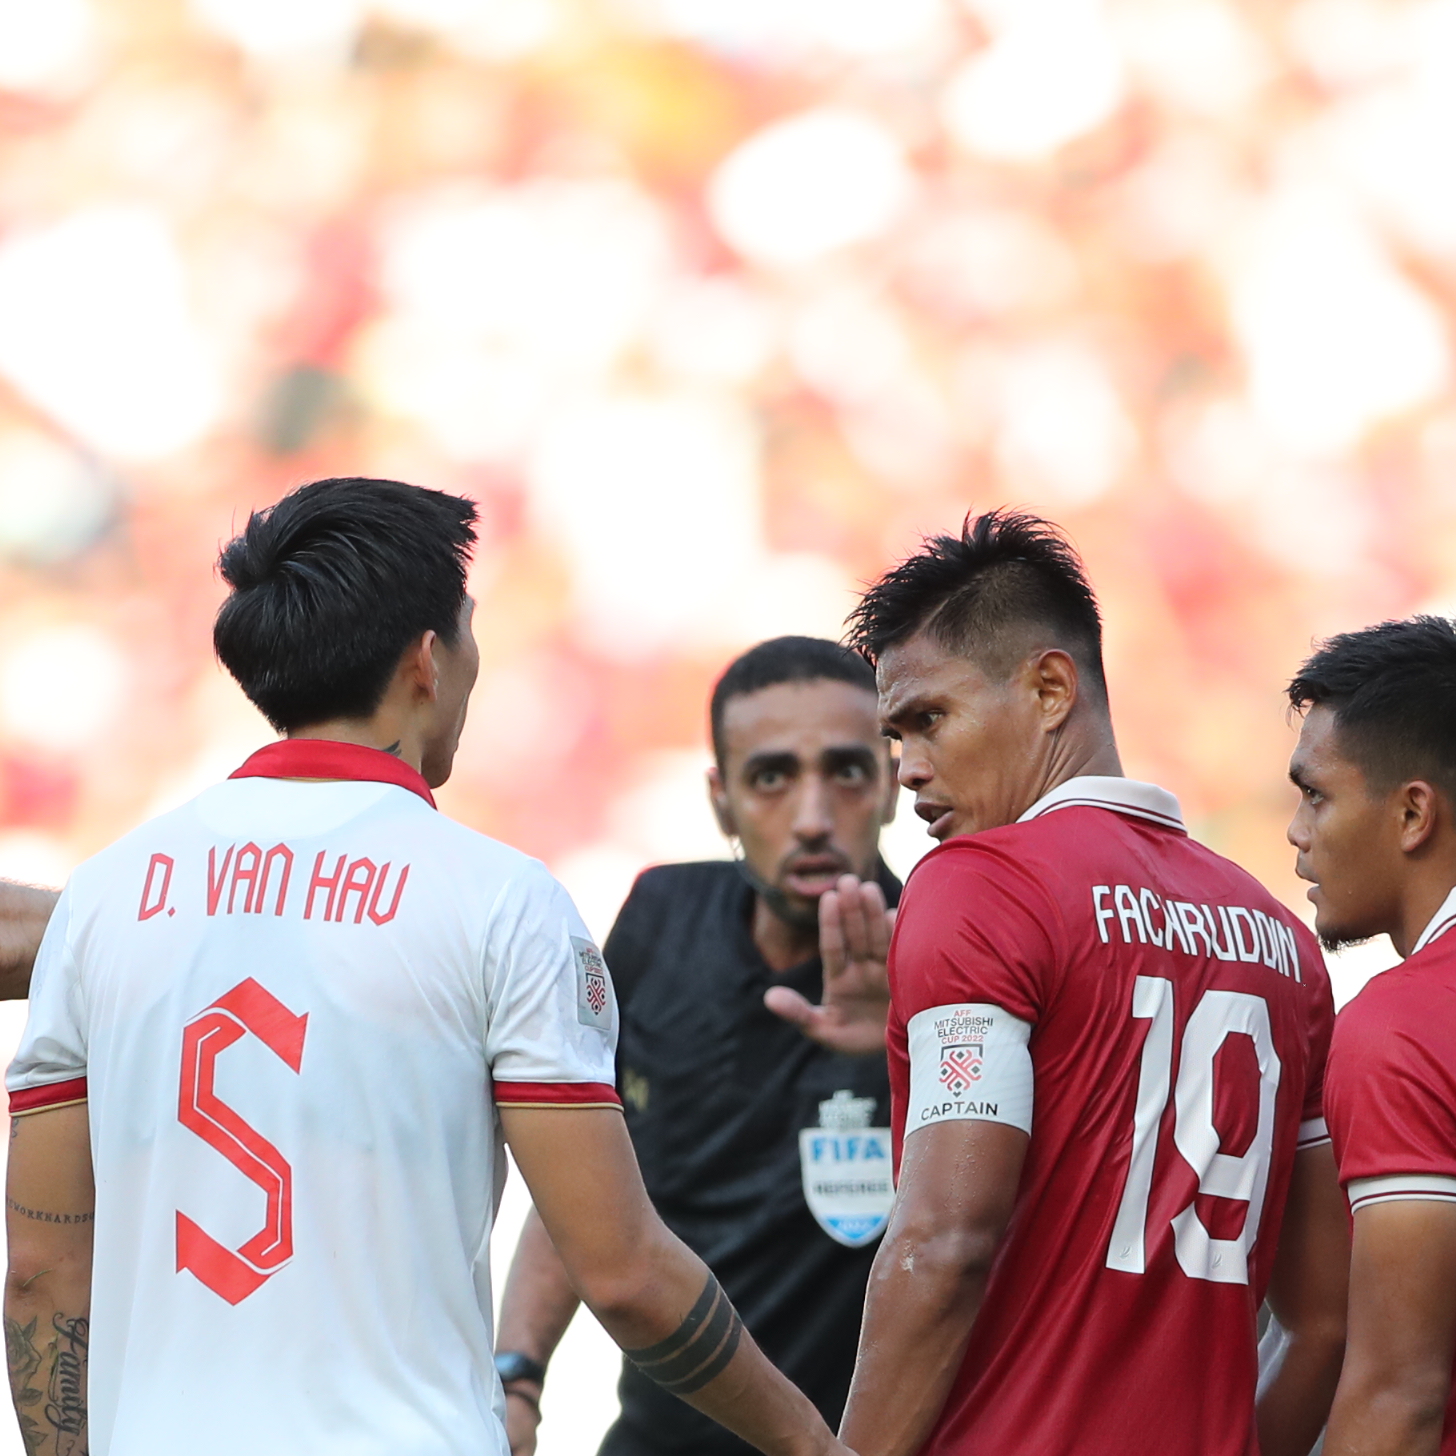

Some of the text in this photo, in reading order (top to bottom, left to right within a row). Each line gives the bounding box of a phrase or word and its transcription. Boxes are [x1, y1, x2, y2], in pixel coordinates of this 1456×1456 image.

[137, 841, 411, 926] D. VAN HAU
[1092, 884, 1302, 984] FACHRUDDIN
[934, 1017, 994, 1030] MITSUBISHI
[953, 1009, 972, 1018] AFF
[938, 1026, 988, 1038] ELECTRIC
[941, 1034, 984, 1044] CUP 2022
[921, 1101, 998, 1121] CAPTAIN
[1106, 975, 1282, 1286] 19
[811, 1136, 885, 1163] FIFA
